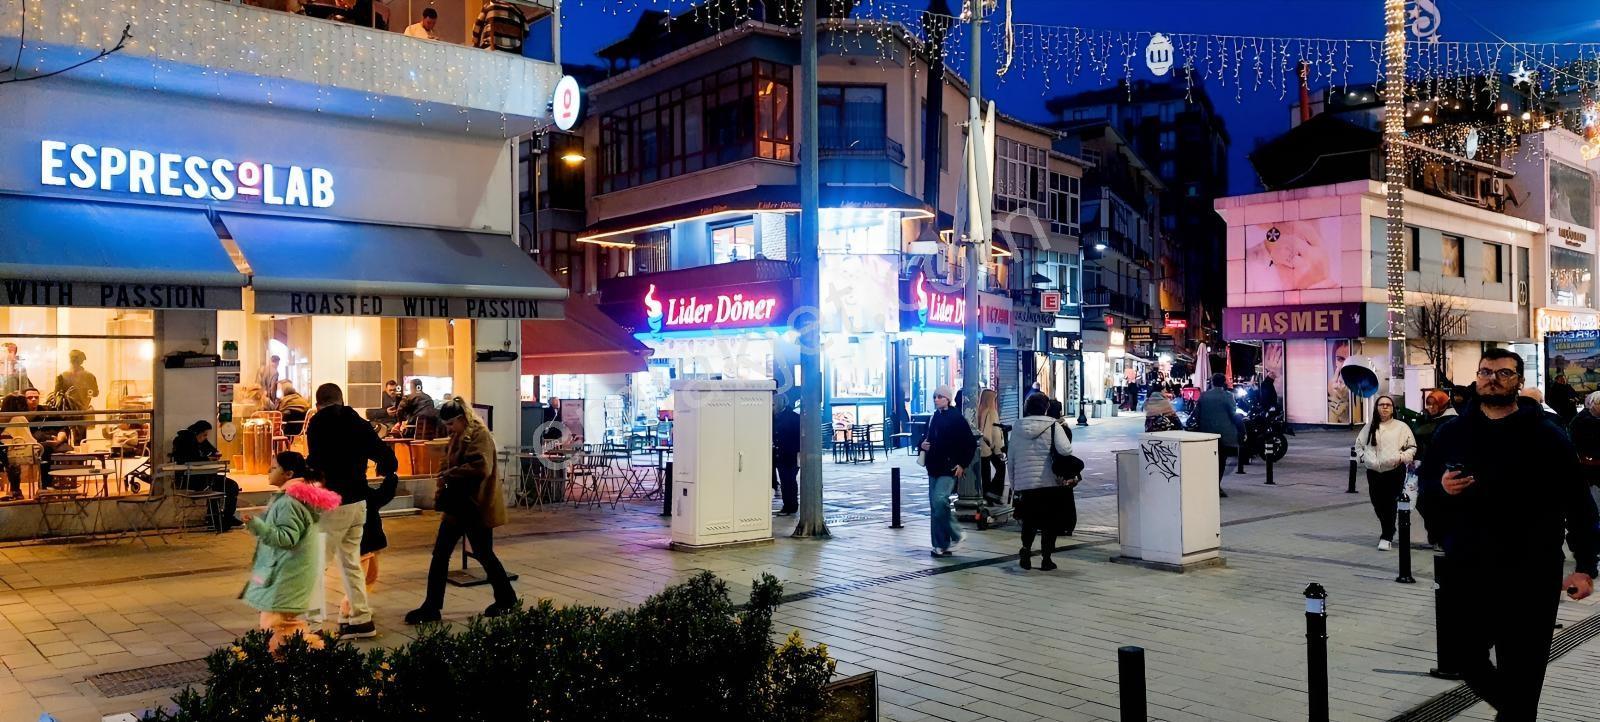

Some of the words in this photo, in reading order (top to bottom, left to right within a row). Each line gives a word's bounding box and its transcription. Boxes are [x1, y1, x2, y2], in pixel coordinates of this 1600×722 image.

[40, 139, 336, 209] ESPRESSOLAB
[5, 279, 73, 305] WITH
[100, 284, 206, 309] PASSION
[290, 292, 383, 315] ROASTED
[402, 296, 449, 317] WITH
[465, 298, 539, 319] PASSION
[666, 296, 713, 325] Lider
[714, 293, 777, 324] Döner
[929, 292, 954, 323] Lider
[1240, 309, 1343, 336] HAŞMET
